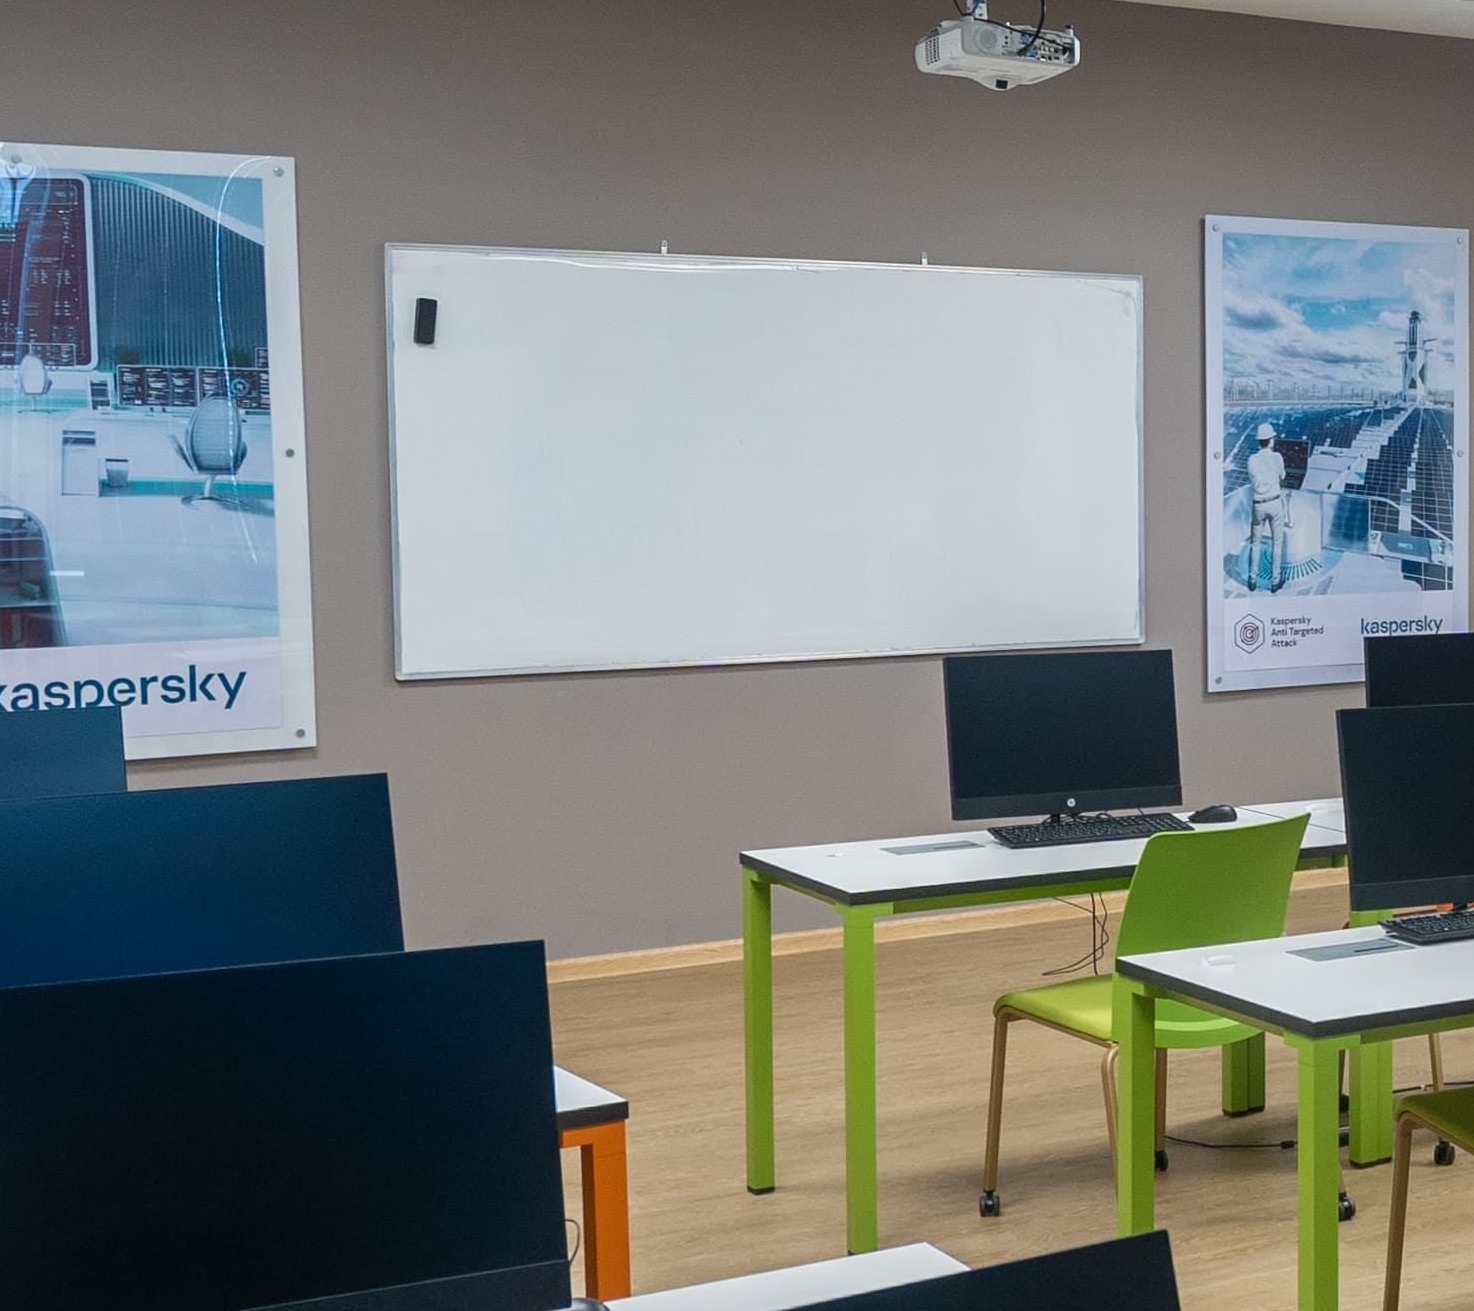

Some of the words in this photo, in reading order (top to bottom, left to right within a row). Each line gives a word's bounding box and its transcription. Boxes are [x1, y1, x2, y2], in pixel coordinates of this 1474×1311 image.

[1270, 615, 1312, 627] Kaspersky
[1360, 615, 1444, 637] kaspersky
[1270, 627, 1288, 637] Anti
[1289, 626, 1324, 638] Targeted
[1270, 637, 1298, 649] Attack
